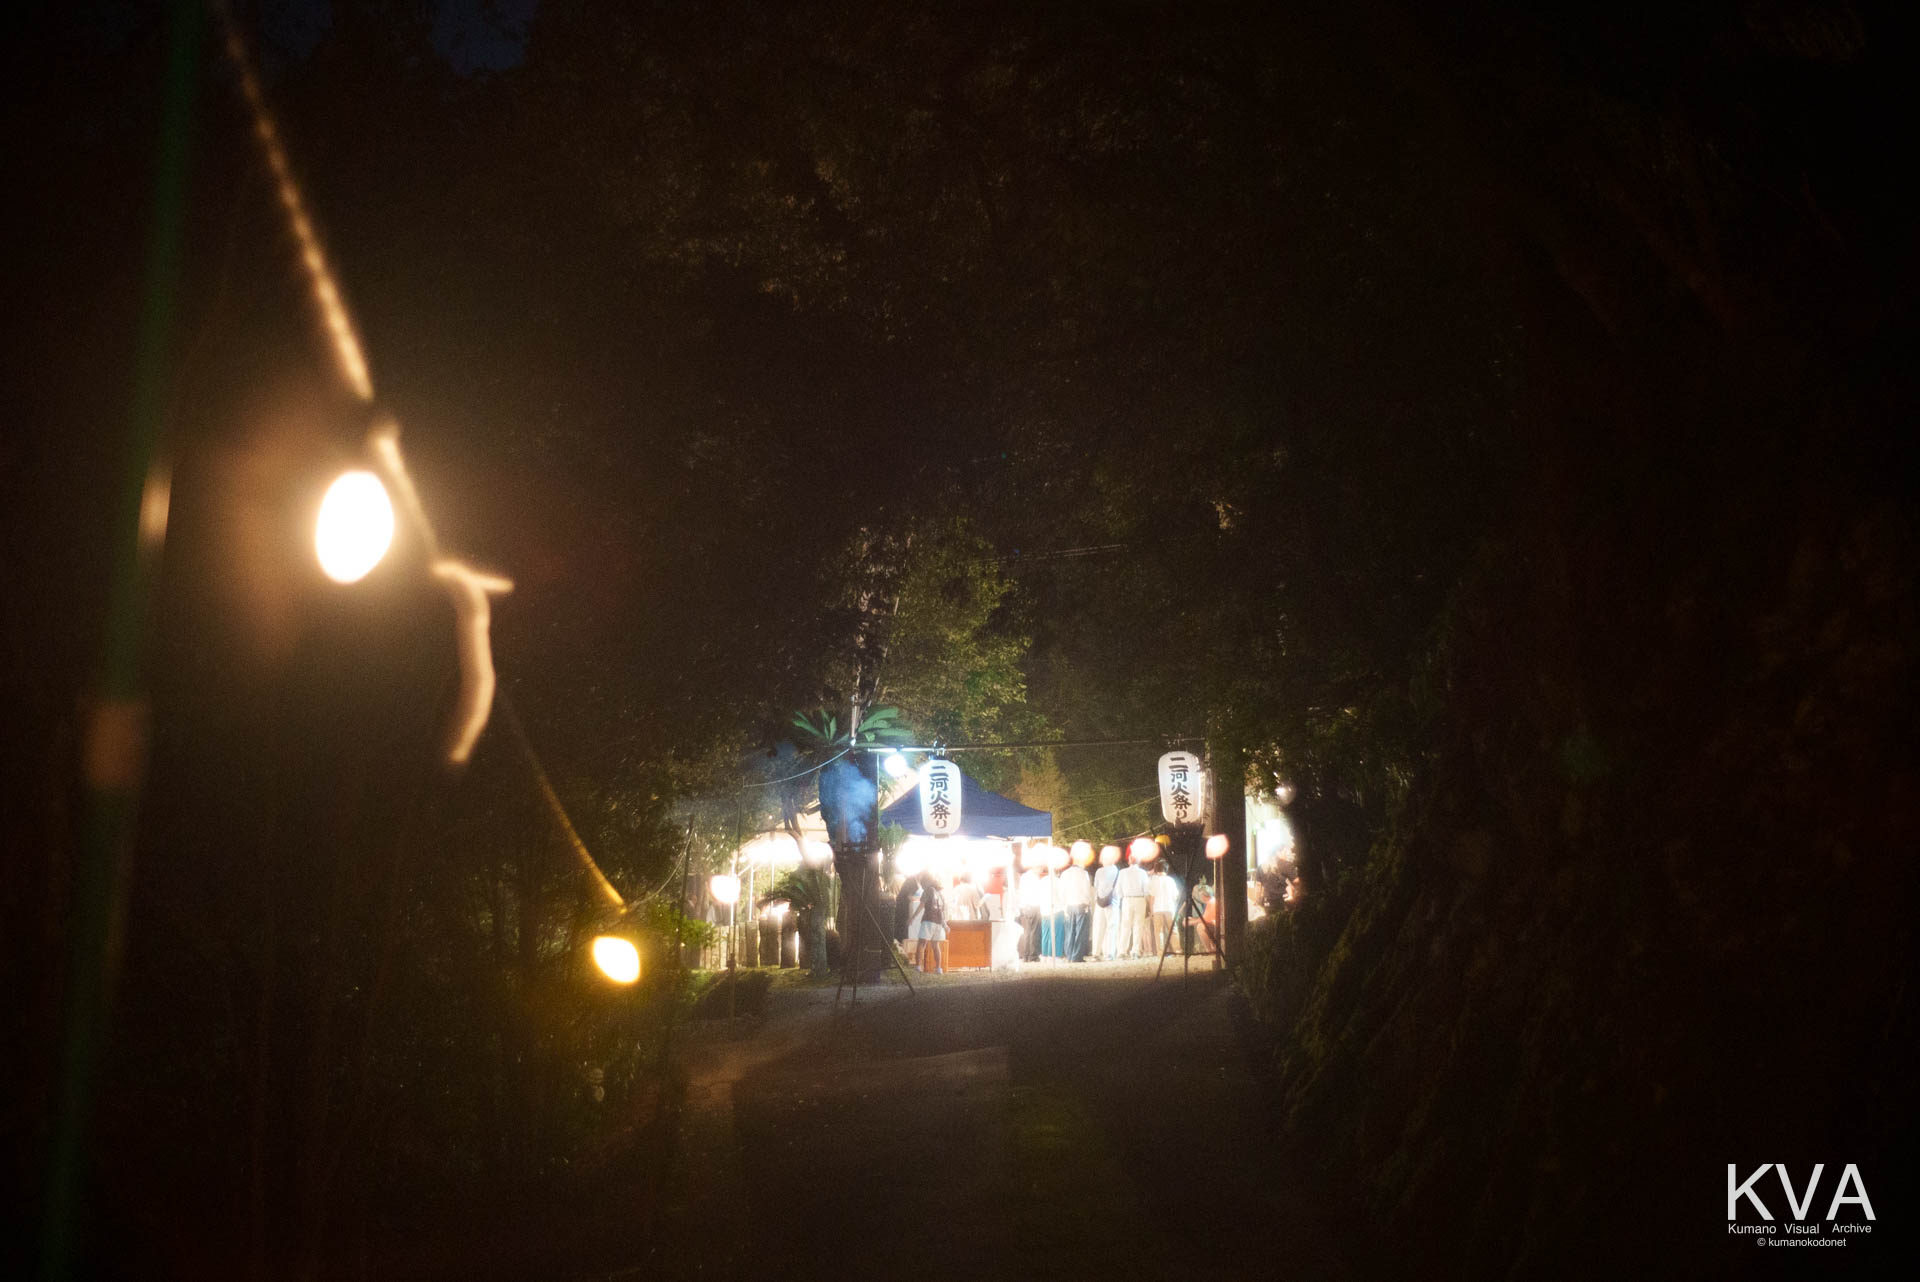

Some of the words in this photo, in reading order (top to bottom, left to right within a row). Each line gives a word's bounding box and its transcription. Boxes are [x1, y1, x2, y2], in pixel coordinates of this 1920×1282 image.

[928, 765, 951, 829] 二河火祭り
[1168, 756, 1192, 819] 二河火祭り
